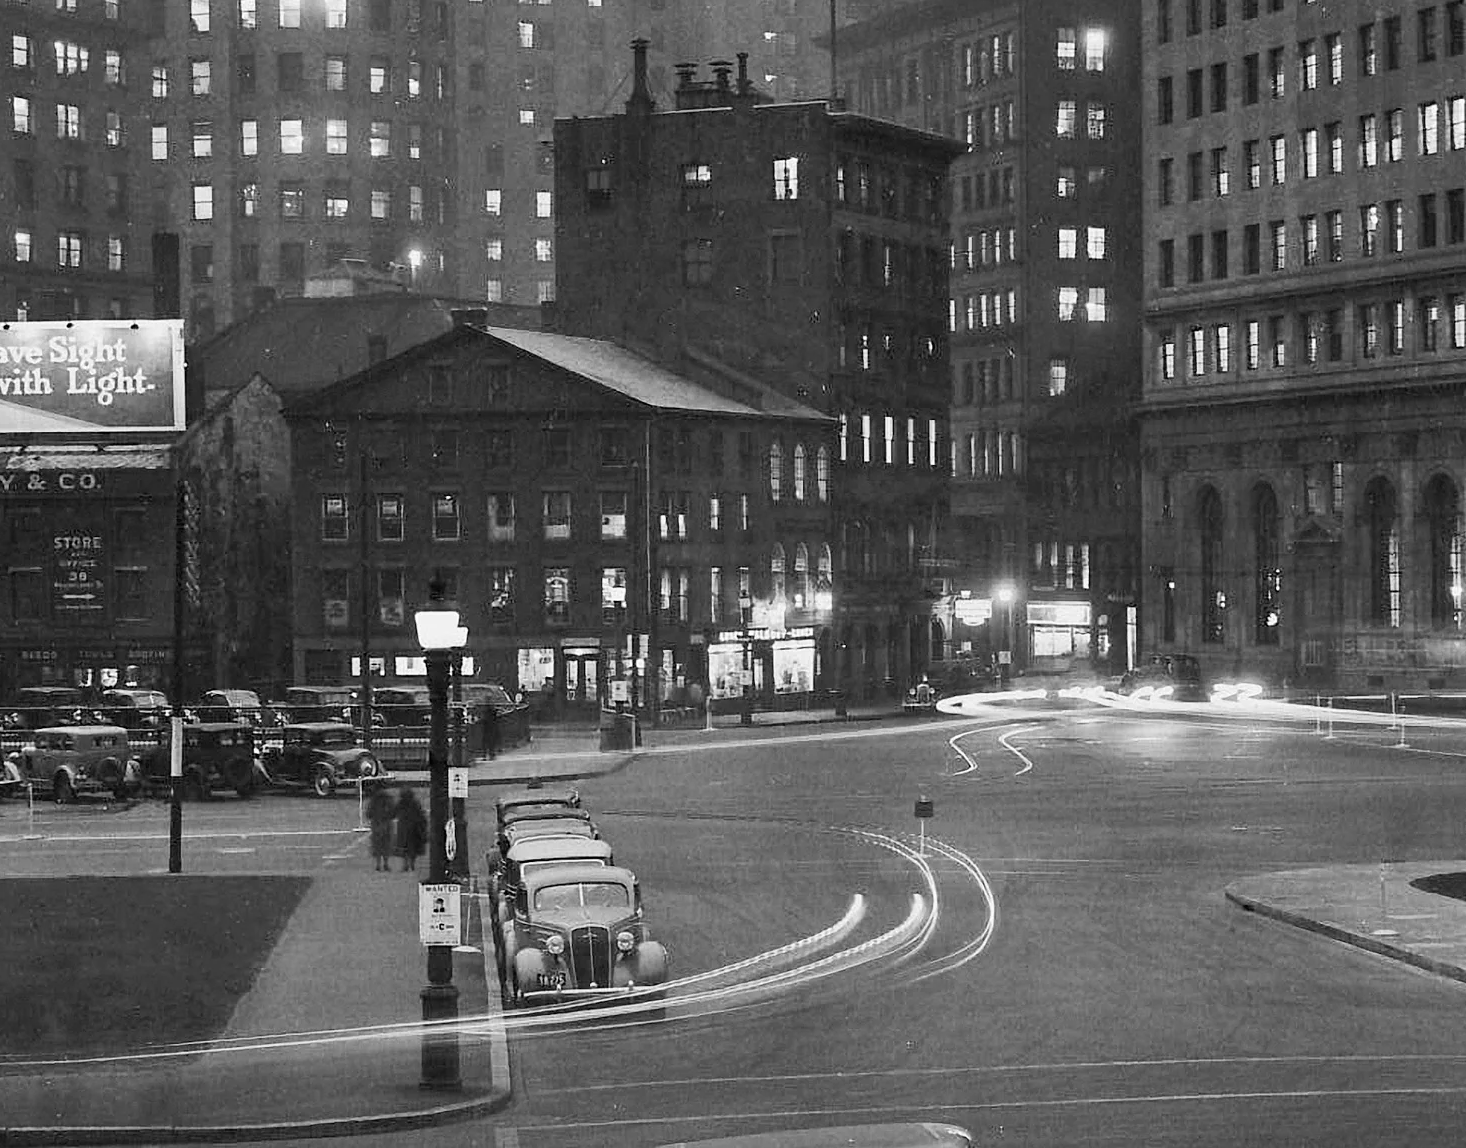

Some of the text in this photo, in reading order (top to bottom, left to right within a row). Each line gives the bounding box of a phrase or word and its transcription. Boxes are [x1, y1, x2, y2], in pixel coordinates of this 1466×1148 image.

[49, 336, 127, 370] Sight
[27, 474, 47, 491] &
[59, 473, 102, 490] CO.
[54, 536, 102, 549] STORE
